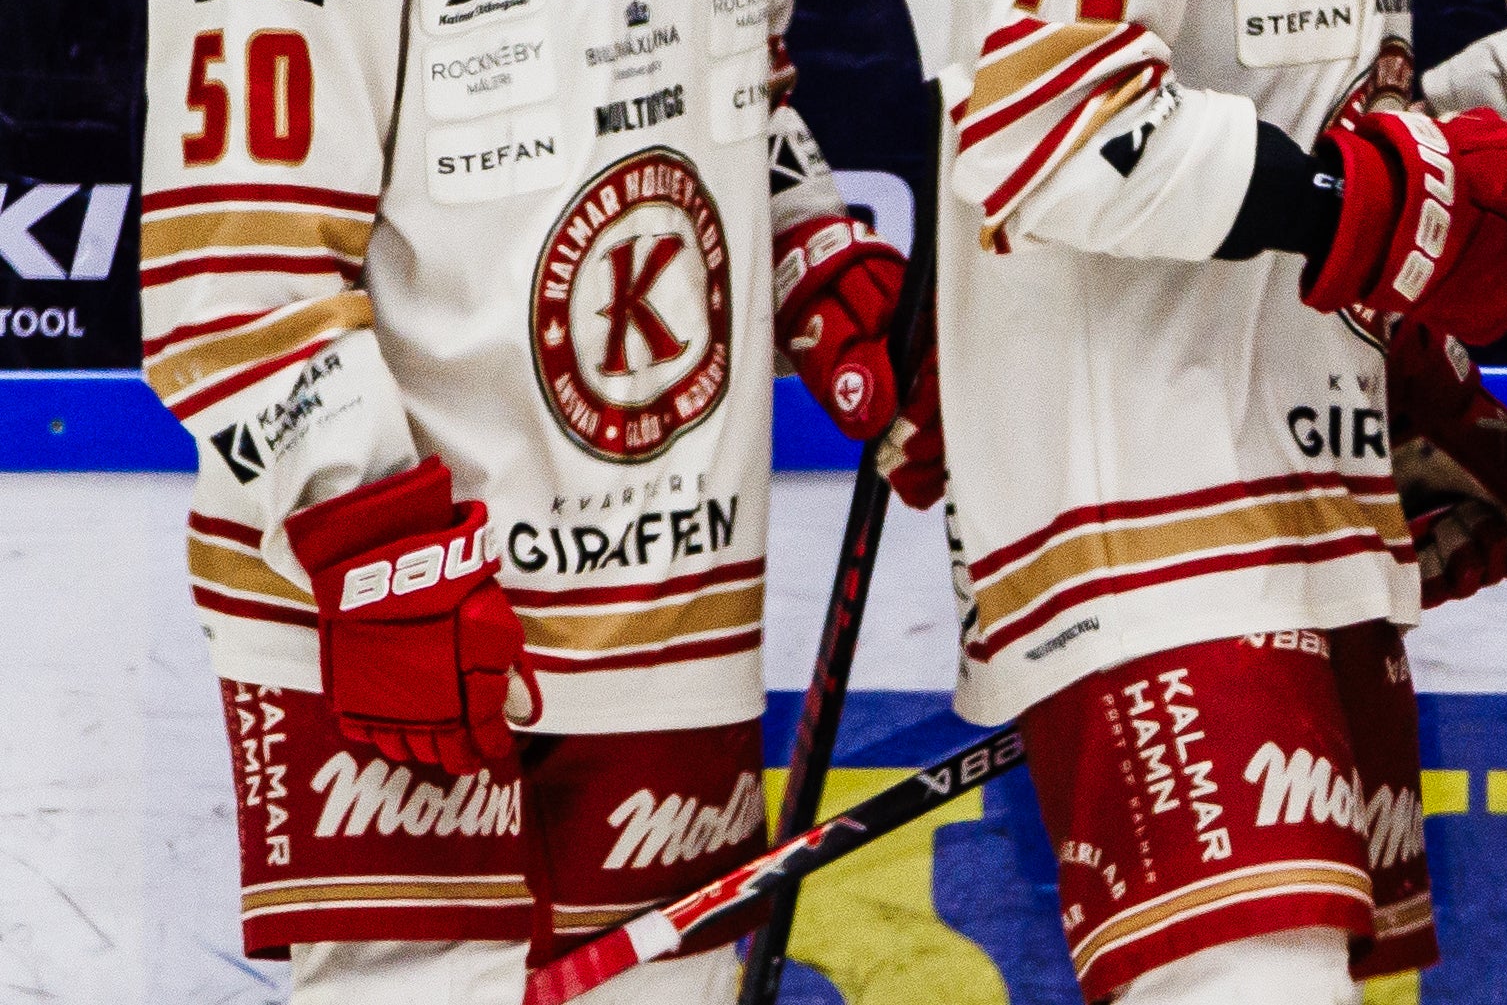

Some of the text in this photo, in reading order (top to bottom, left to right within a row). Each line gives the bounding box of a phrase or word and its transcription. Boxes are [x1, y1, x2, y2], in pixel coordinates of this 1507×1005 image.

[1245, 6, 1351, 37] STEFAN
[181, 27, 315, 169] 50
[437, 136, 556, 175] STEFAN
[545, 184, 622, 301] KALMAR
[596, 232, 690, 376] K
[1122, 679, 1181, 815] HAMN
[1157, 667, 1233, 863] KALMAR
